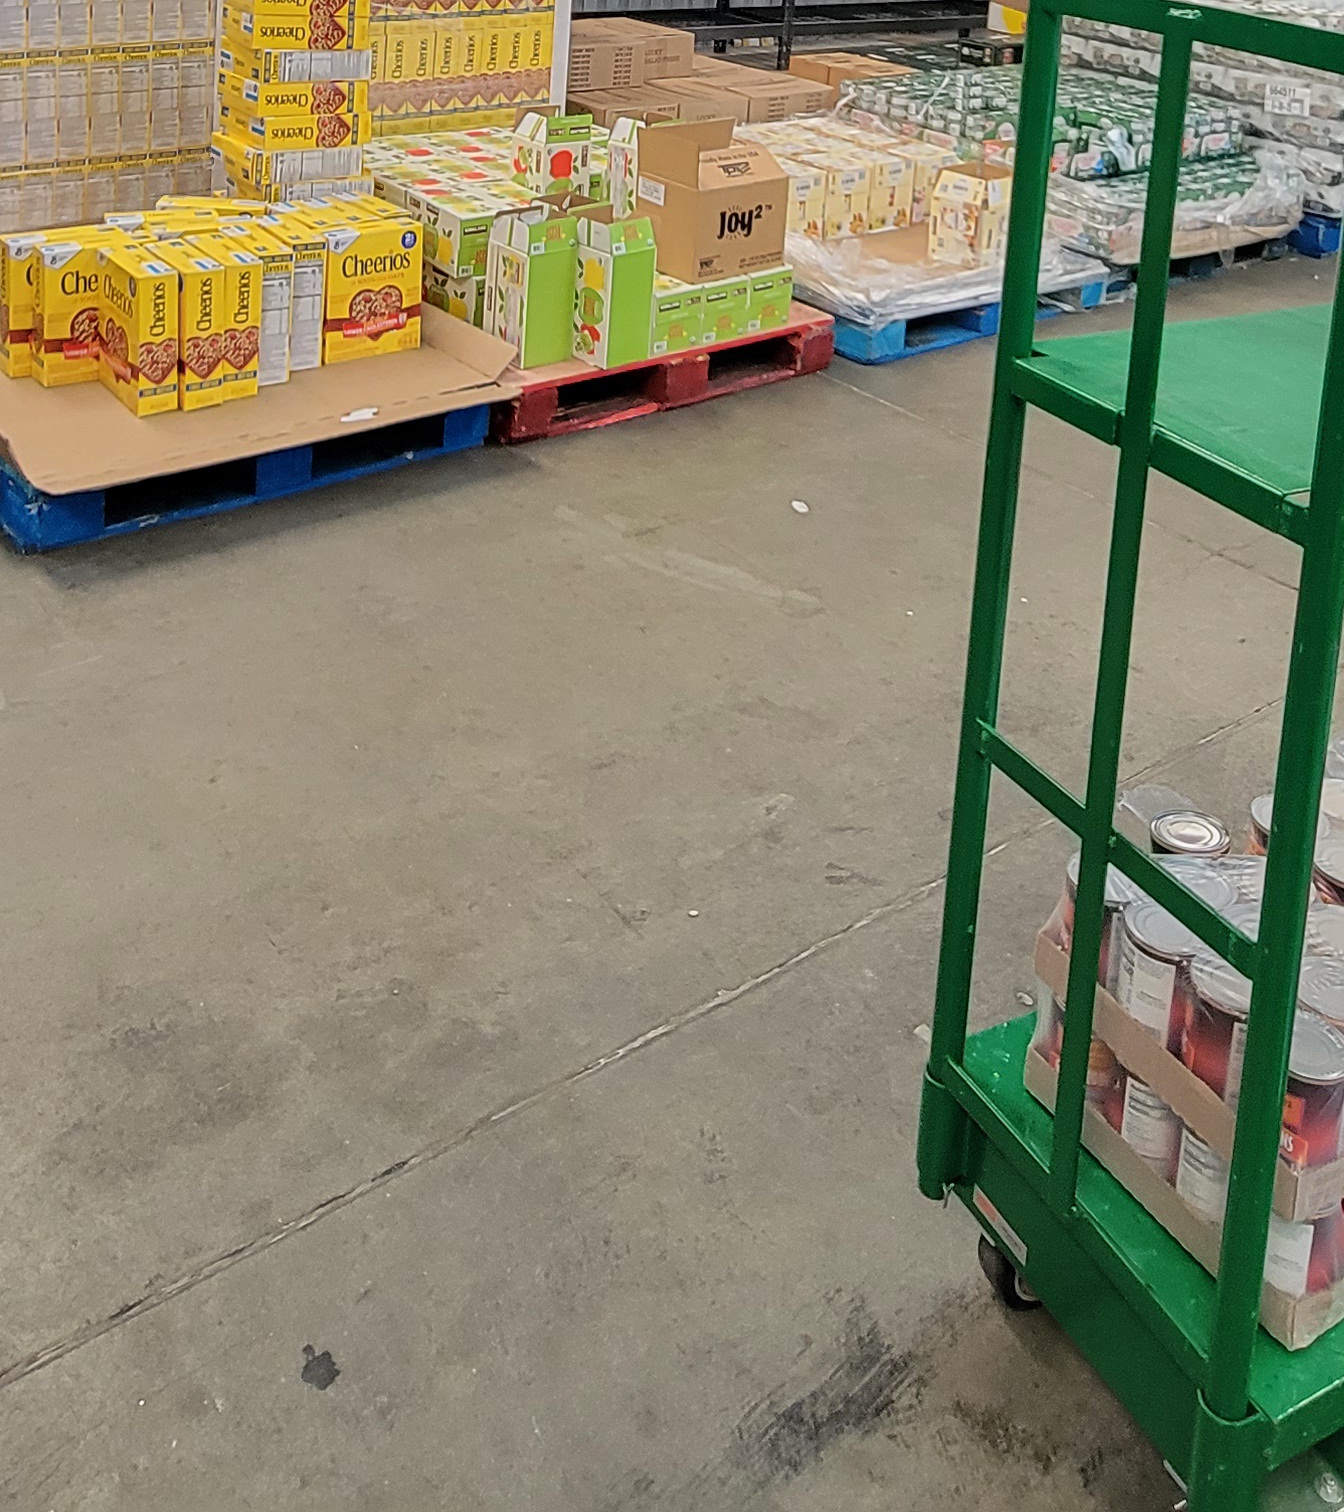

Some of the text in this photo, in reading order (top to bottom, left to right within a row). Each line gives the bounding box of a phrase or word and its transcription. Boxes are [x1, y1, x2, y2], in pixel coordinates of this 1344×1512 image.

[259, 25, 306, 42] Cheerios
[486, 32, 500, 72] Cheerios
[508, 31, 522, 70] Cheerios
[529, 29, 542, 67] Cheerios
[391, 39, 404, 79] Cheerios
[416, 38, 429, 78] Cheerios
[440, 36, 454, 75] Cheerios
[463, 34, 476, 73] Cheerios
[265, 93, 309, 108] Cheerios
[271, 125, 315, 142] Cheerios
[341, 248, 411, 280] Cheerios
[103, 273, 135, 319] Cheerios
[149, 281, 167, 338] Cheerios
[196, 277, 213, 332] Cheerios
[233, 270, 252, 325] Cheerios
